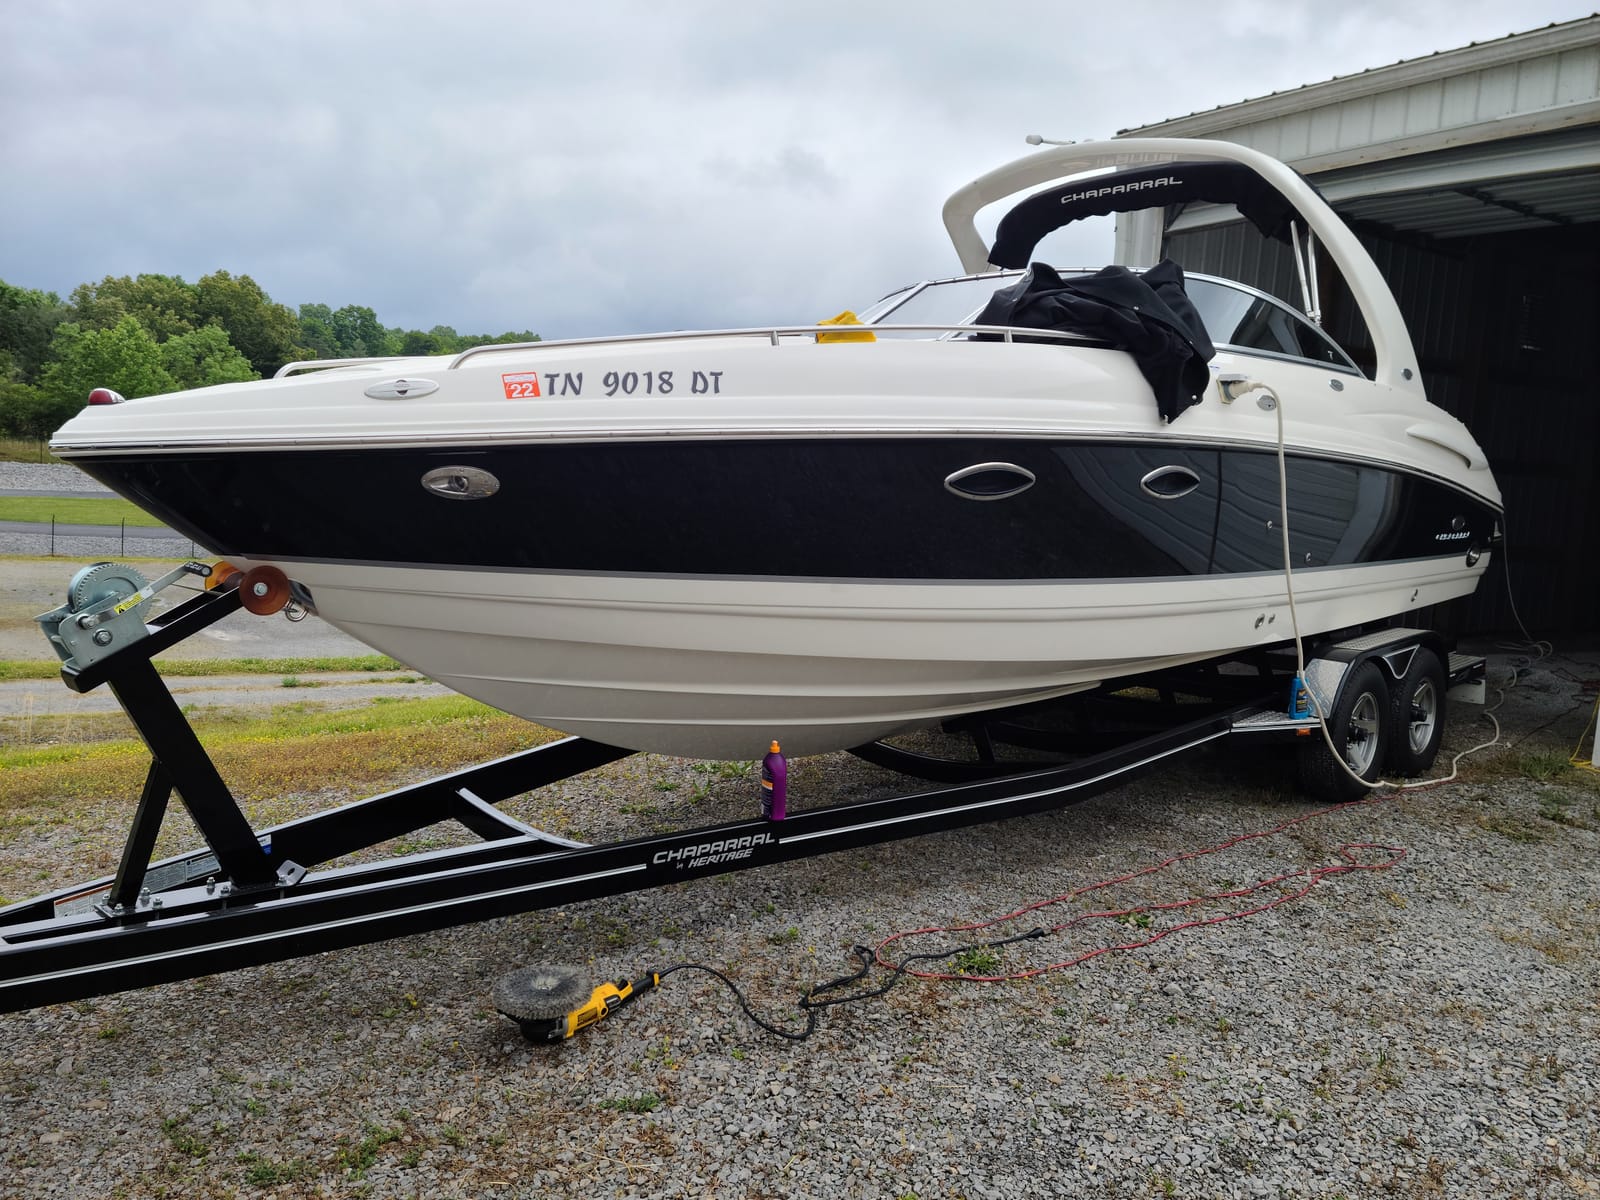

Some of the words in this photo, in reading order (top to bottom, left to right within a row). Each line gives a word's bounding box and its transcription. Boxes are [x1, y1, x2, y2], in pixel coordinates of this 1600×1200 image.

[1060, 176, 1183, 204] CHAPARRAL
[510, 383, 536, 398] 22
[543, 372, 583, 397] TN
[602, 371, 674, 397] 9018
[690, 371, 724, 395] DT
[652, 832, 775, 864] CHAPARRAL
[687, 848, 754, 869] HERITAGE
